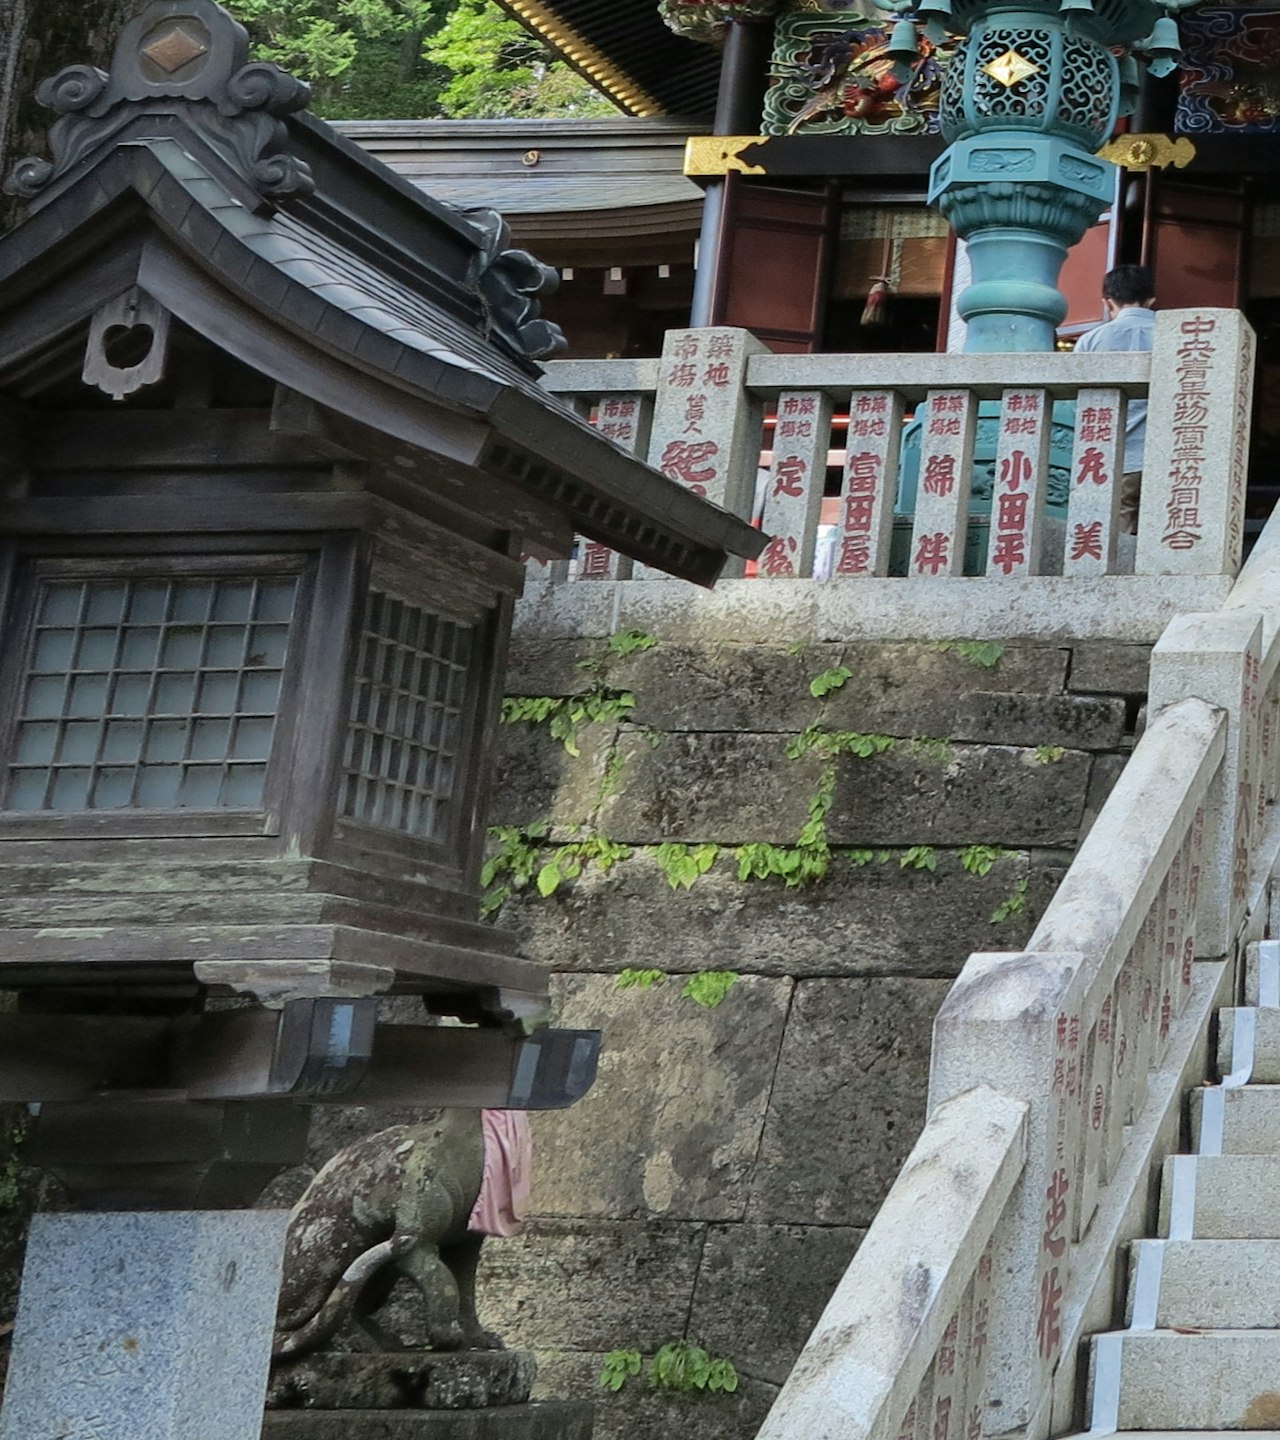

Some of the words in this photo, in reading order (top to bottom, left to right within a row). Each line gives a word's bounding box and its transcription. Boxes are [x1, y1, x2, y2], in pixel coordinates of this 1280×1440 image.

[837, 452, 882, 574] 富田屋
[992, 449, 1033, 575] 小田平
